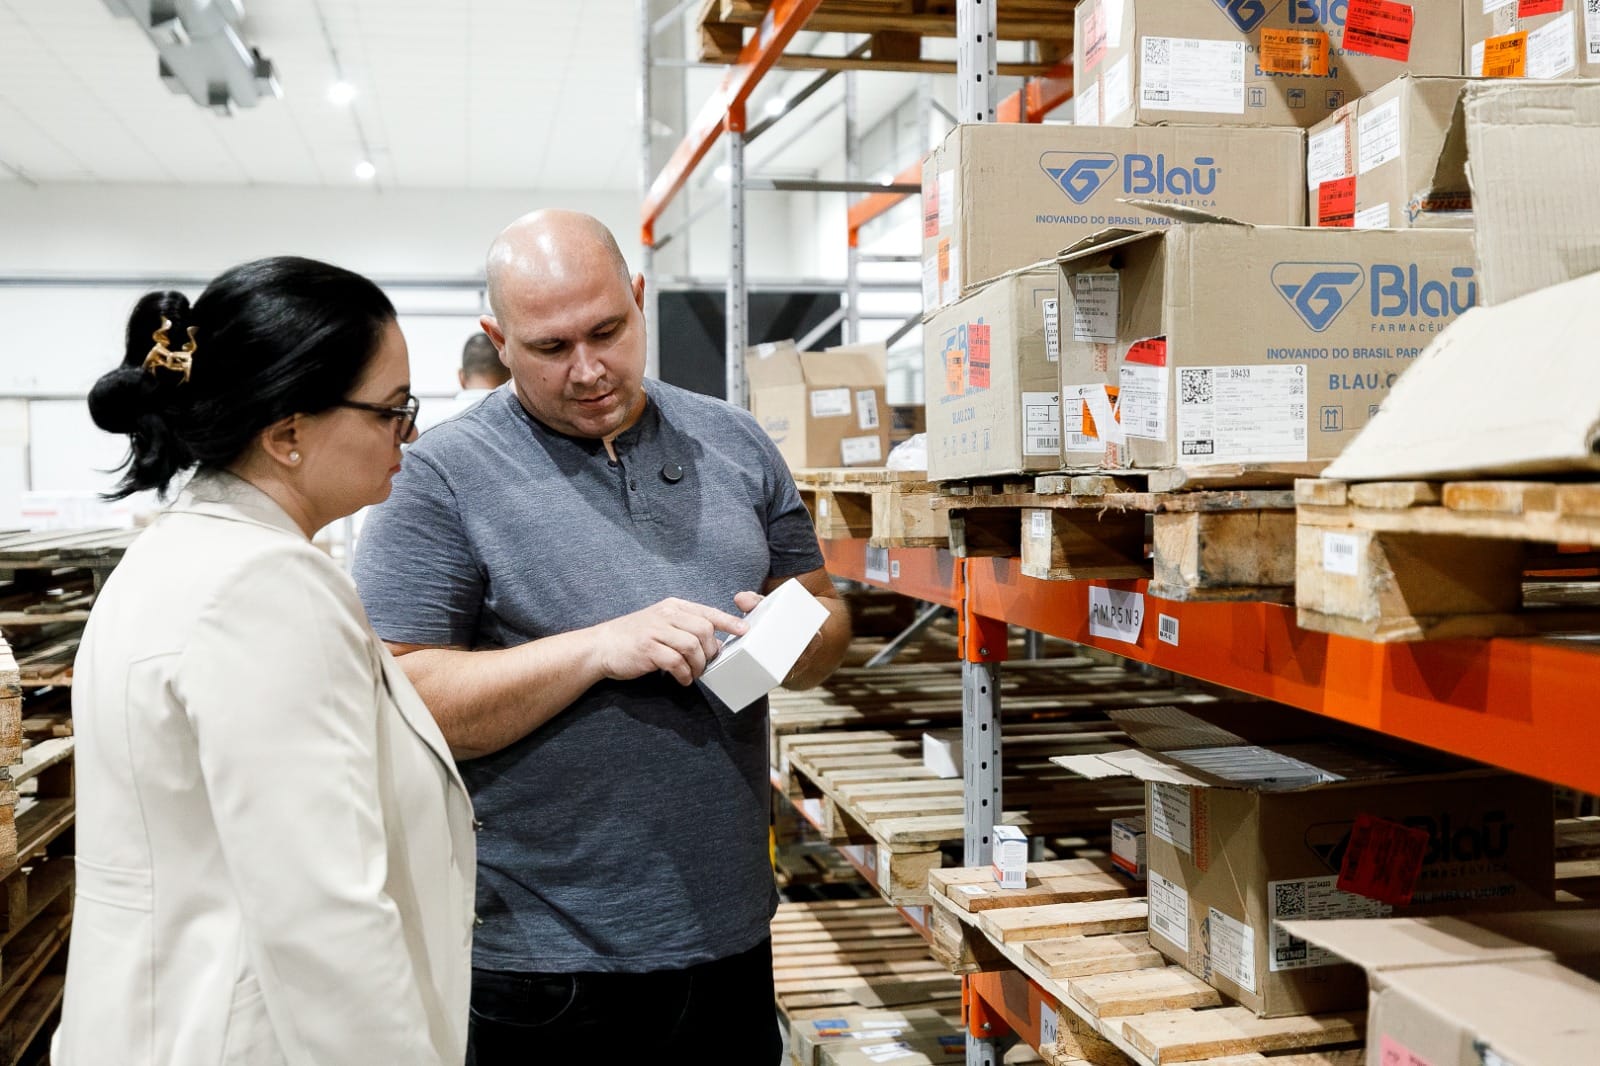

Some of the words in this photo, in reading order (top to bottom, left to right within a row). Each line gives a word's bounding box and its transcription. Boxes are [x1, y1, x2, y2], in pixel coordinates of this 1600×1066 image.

[1035, 215, 1088, 224] INOVANDO
[1091, 215, 1105, 225] DO
[1108, 216, 1143, 225] BRASIL
[1146, 217, 1170, 226] PARA
[1371, 322, 1445, 332] FARMACÊU
[1266, 347, 1329, 360] INOVANDO
[1332, 348, 1349, 359] DO
[1353, 348, 1393, 359] BRASIL
[1329, 373, 1398, 391] BLAU.C
